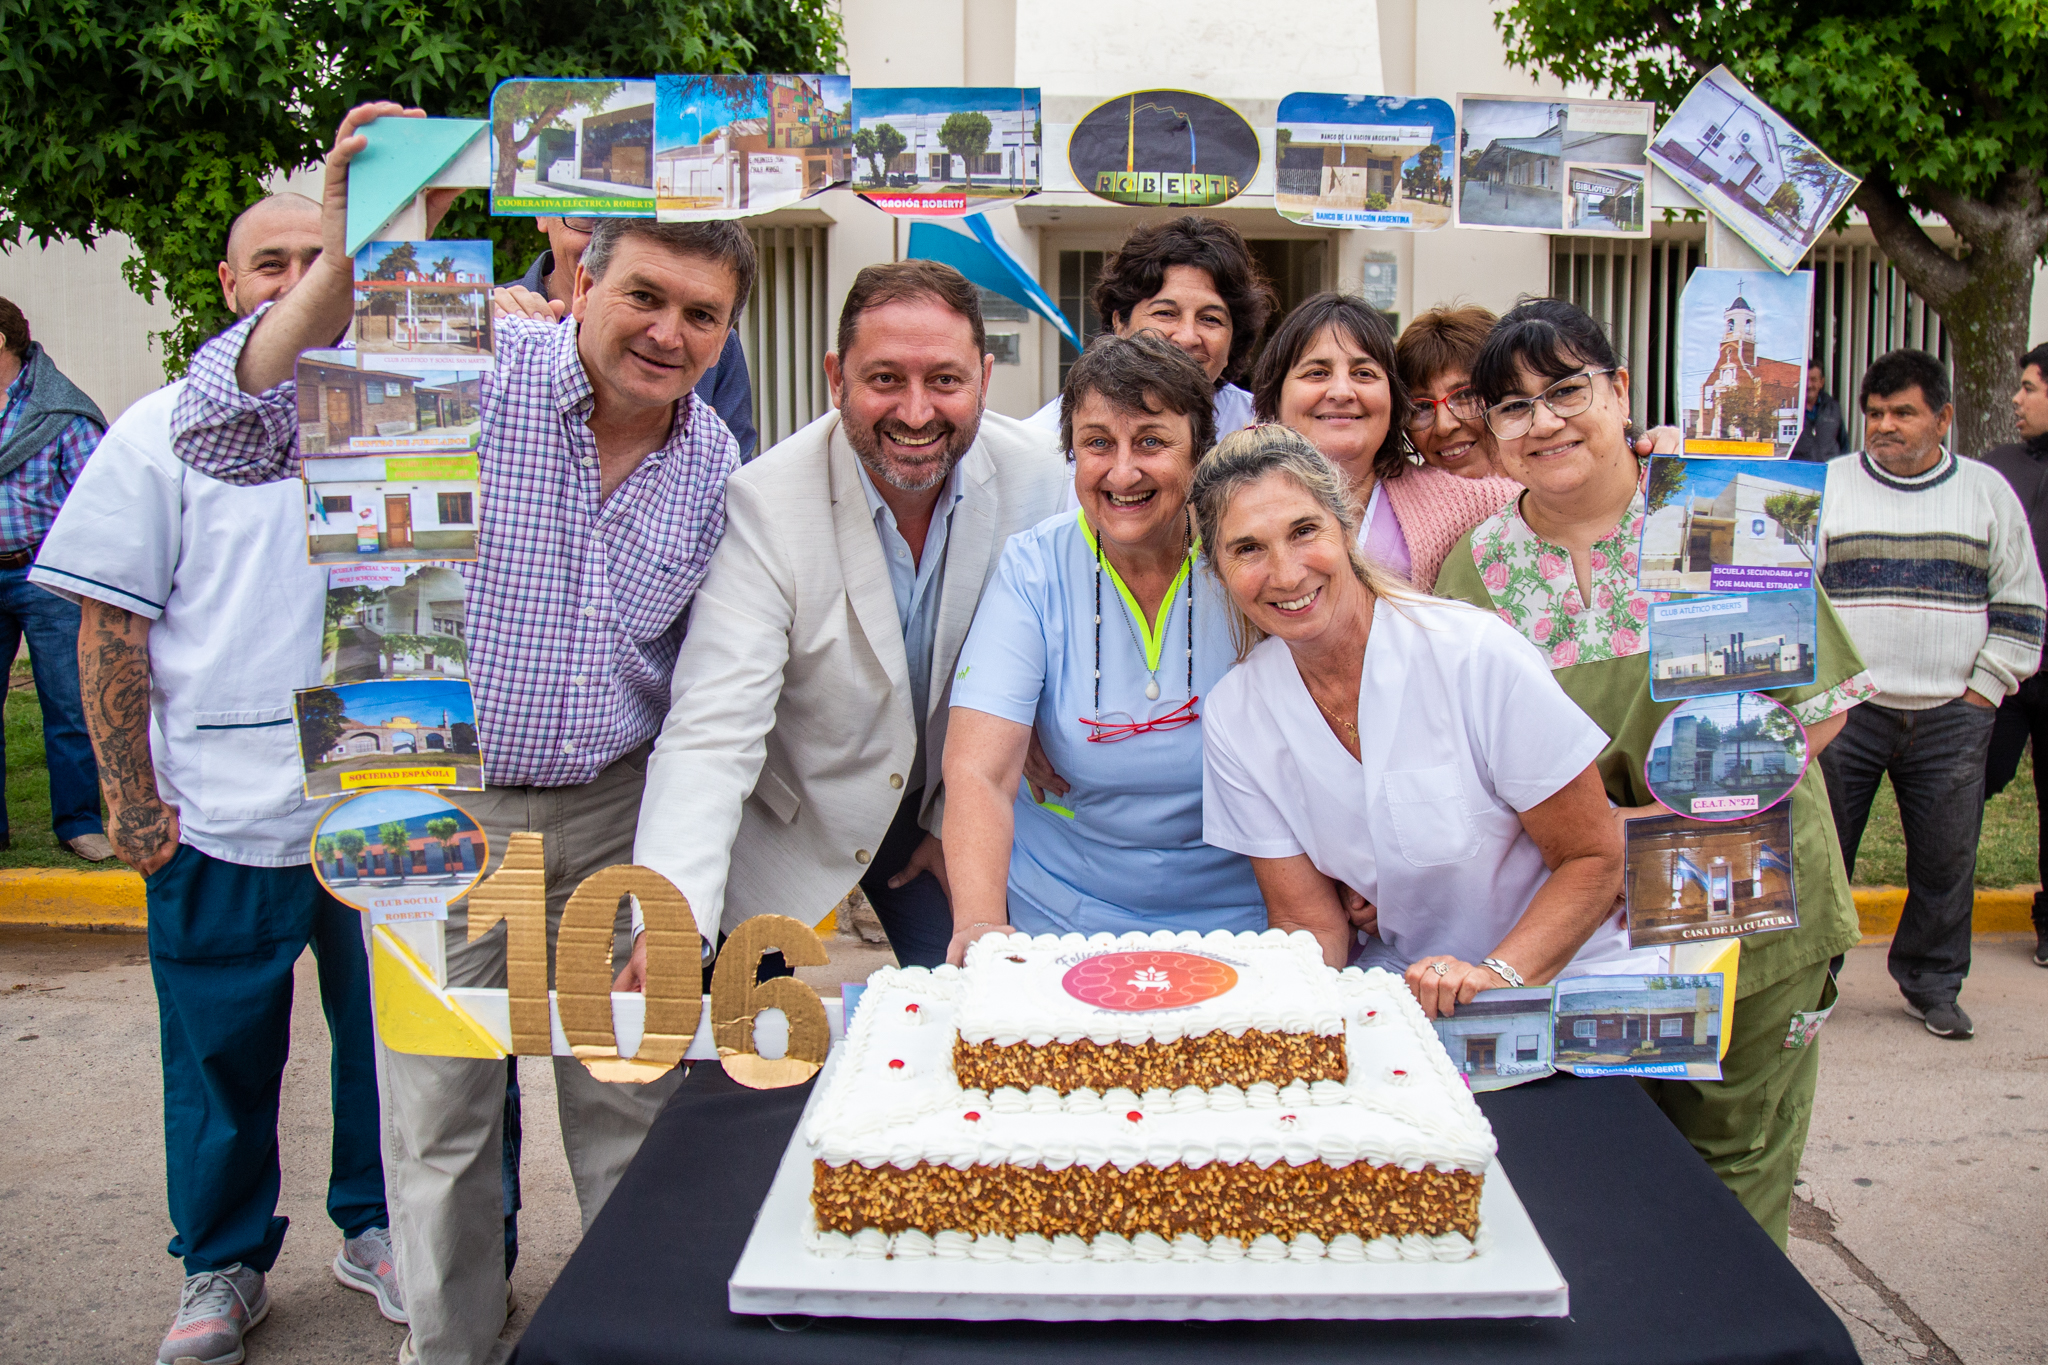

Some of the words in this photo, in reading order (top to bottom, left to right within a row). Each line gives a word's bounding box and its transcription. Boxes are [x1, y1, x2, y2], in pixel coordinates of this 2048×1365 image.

[1099, 175, 1239, 194] ROBERTS
[1575, 182, 1613, 194] BIBLIOTECA
[562, 196, 611, 208] ELÉCTRICA
[613, 199, 654, 208] ROBERTS
[922, 199, 964, 209] ROBERTS
[1316, 212, 1335, 221] BANCO
[1337, 213, 1344, 221] DE
[1345, 214, 1353, 222] LA
[1378, 215, 1410, 224] ARGENTINA
[395, 271, 429, 282] SAN
[434, 271, 486, 284] MARTIN
[352, 439, 394, 448] CENTRO
[396, 439, 410, 447] DE
[411, 437, 468, 447] JUBILADOS
[390, 460, 419, 468] CENTRO
[1713, 567, 1745, 576] ESCUELA
[1746, 568, 1793, 577] SECUNDARIA
[1733, 580, 1765, 589] MANUEL
[1660, 608, 1678, 617] CLUB
[1680, 605, 1711, 615] ATLÉTICO
[1712, 601, 1742, 611] ROBERTS
[349, 771, 400, 781] SOCIEDAD
[402, 768, 450, 779] ESPAÑOLA
[374, 898, 402, 908] CLUB
[403, 896, 442, 906] SOCIAL
[384, 910, 435, 921] ROBERTS
[1682, 927, 1710, 939] CASA
[1711, 925, 1728, 935] DE
[1730, 924, 1743, 933] LA
[1743, 915, 1794, 931] CULTURA
[468, 832, 830, 1089] 106
[1644, 1064, 1685, 1074] ROBERTS
